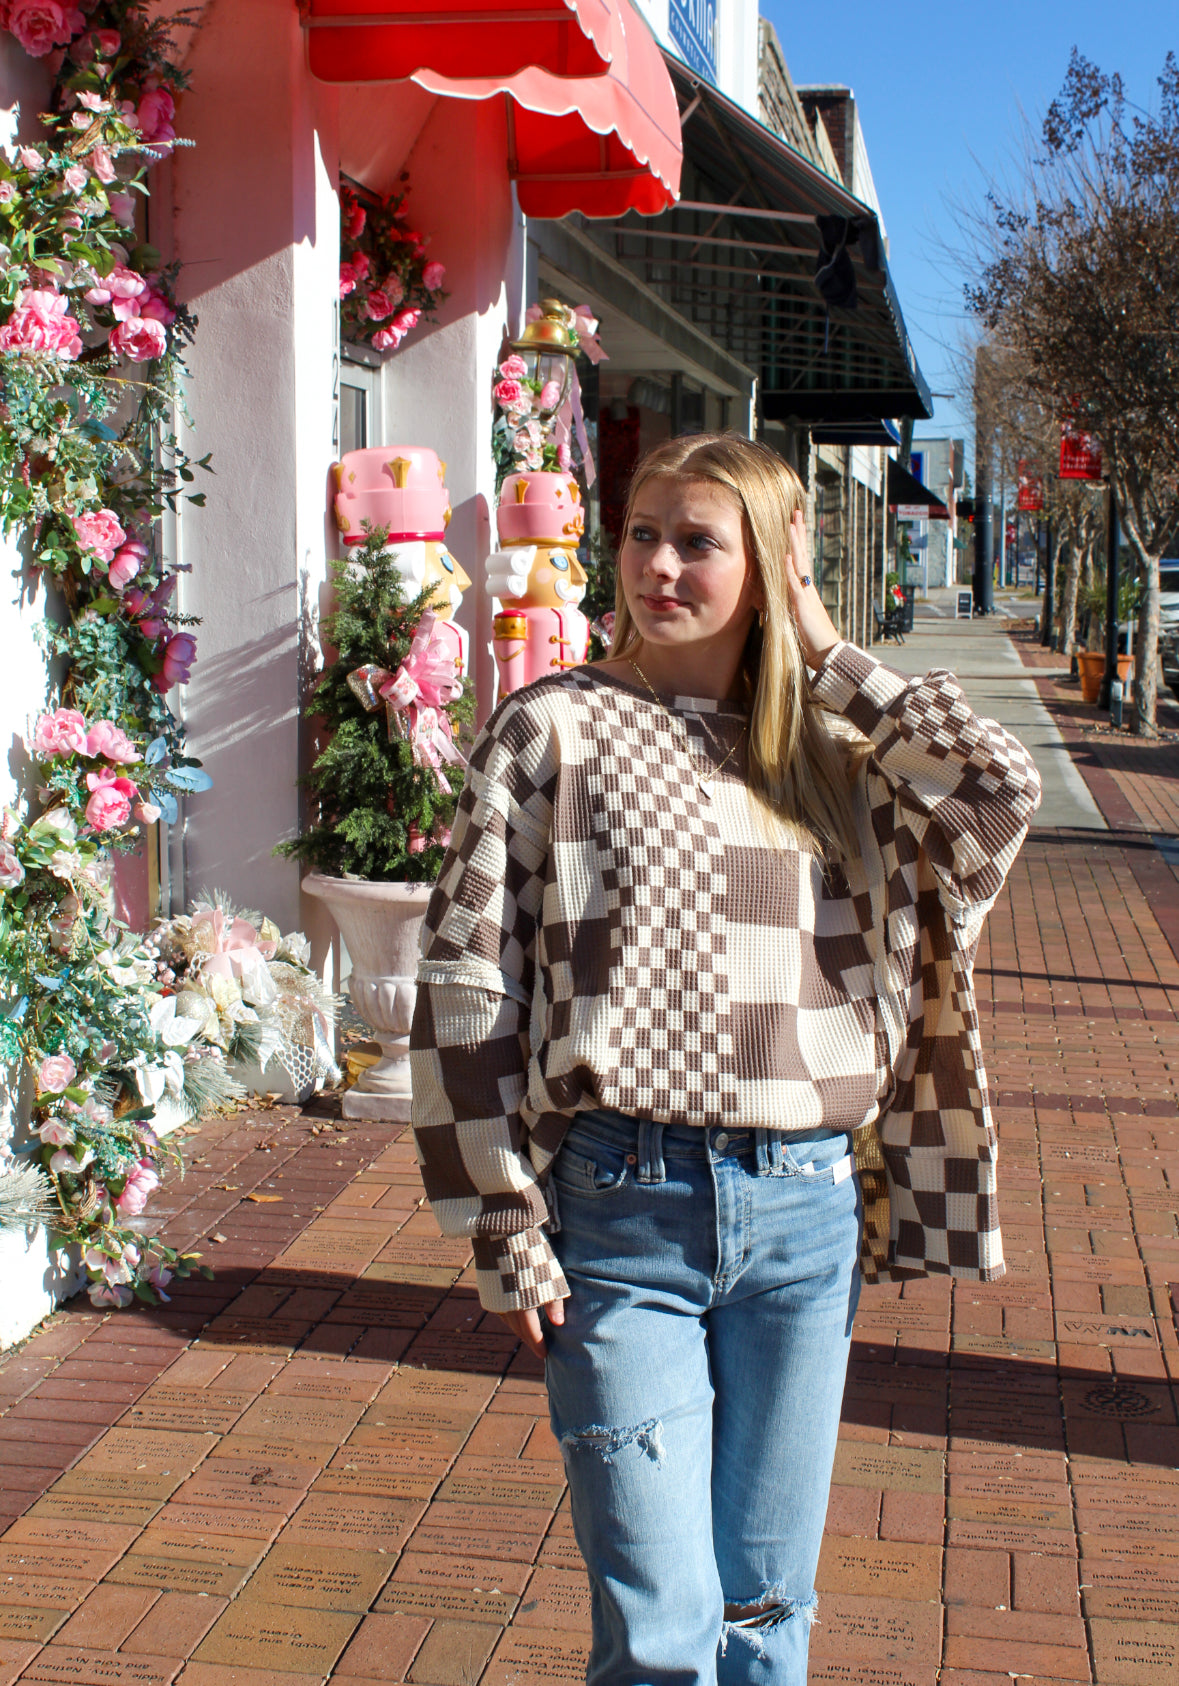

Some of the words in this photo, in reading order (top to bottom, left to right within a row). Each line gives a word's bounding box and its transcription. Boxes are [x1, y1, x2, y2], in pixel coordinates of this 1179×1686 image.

[984, 1482, 1033, 1490] Campbell
[975, 1511, 1027, 1519] Campbell
[1098, 1524, 1150, 1532] Campbell
[986, 1529, 1038, 1538] Campbell
[1101, 1549, 1153, 1557] Campbell
[862, 1564, 908, 1573] Memory
[1092, 1574, 1146, 1582] Campbell
[1123, 1597, 1179, 1605] Campbell
[847, 1630, 898, 1641] Memory
[514, 1643, 562, 1653] Gooden
[1117, 1640, 1175, 1650] Campbell
[1114, 1656, 1173, 1667] Campbell
[37, 1664, 82, 1673] Nathan
[858, 1668, 902, 1678] Hooker
